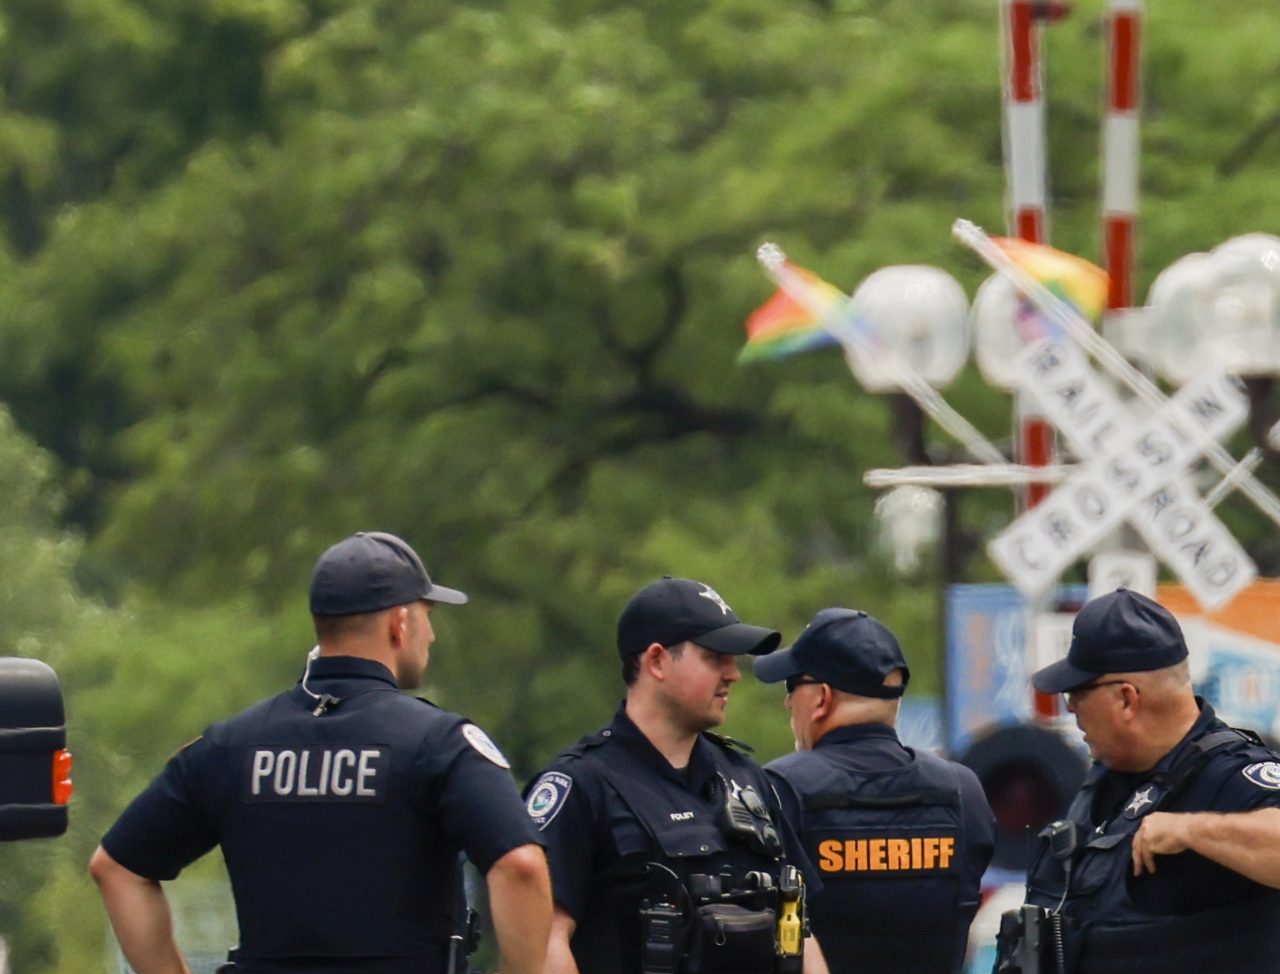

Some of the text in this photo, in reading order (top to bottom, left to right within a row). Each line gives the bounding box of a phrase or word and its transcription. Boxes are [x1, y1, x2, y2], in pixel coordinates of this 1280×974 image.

[1006, 376, 1247, 574] CROSSIN
[1021, 346, 1240, 590] RAIL ROAD
[252, 750, 381, 796] POLICE
[818, 837, 955, 872] SHERIFF
